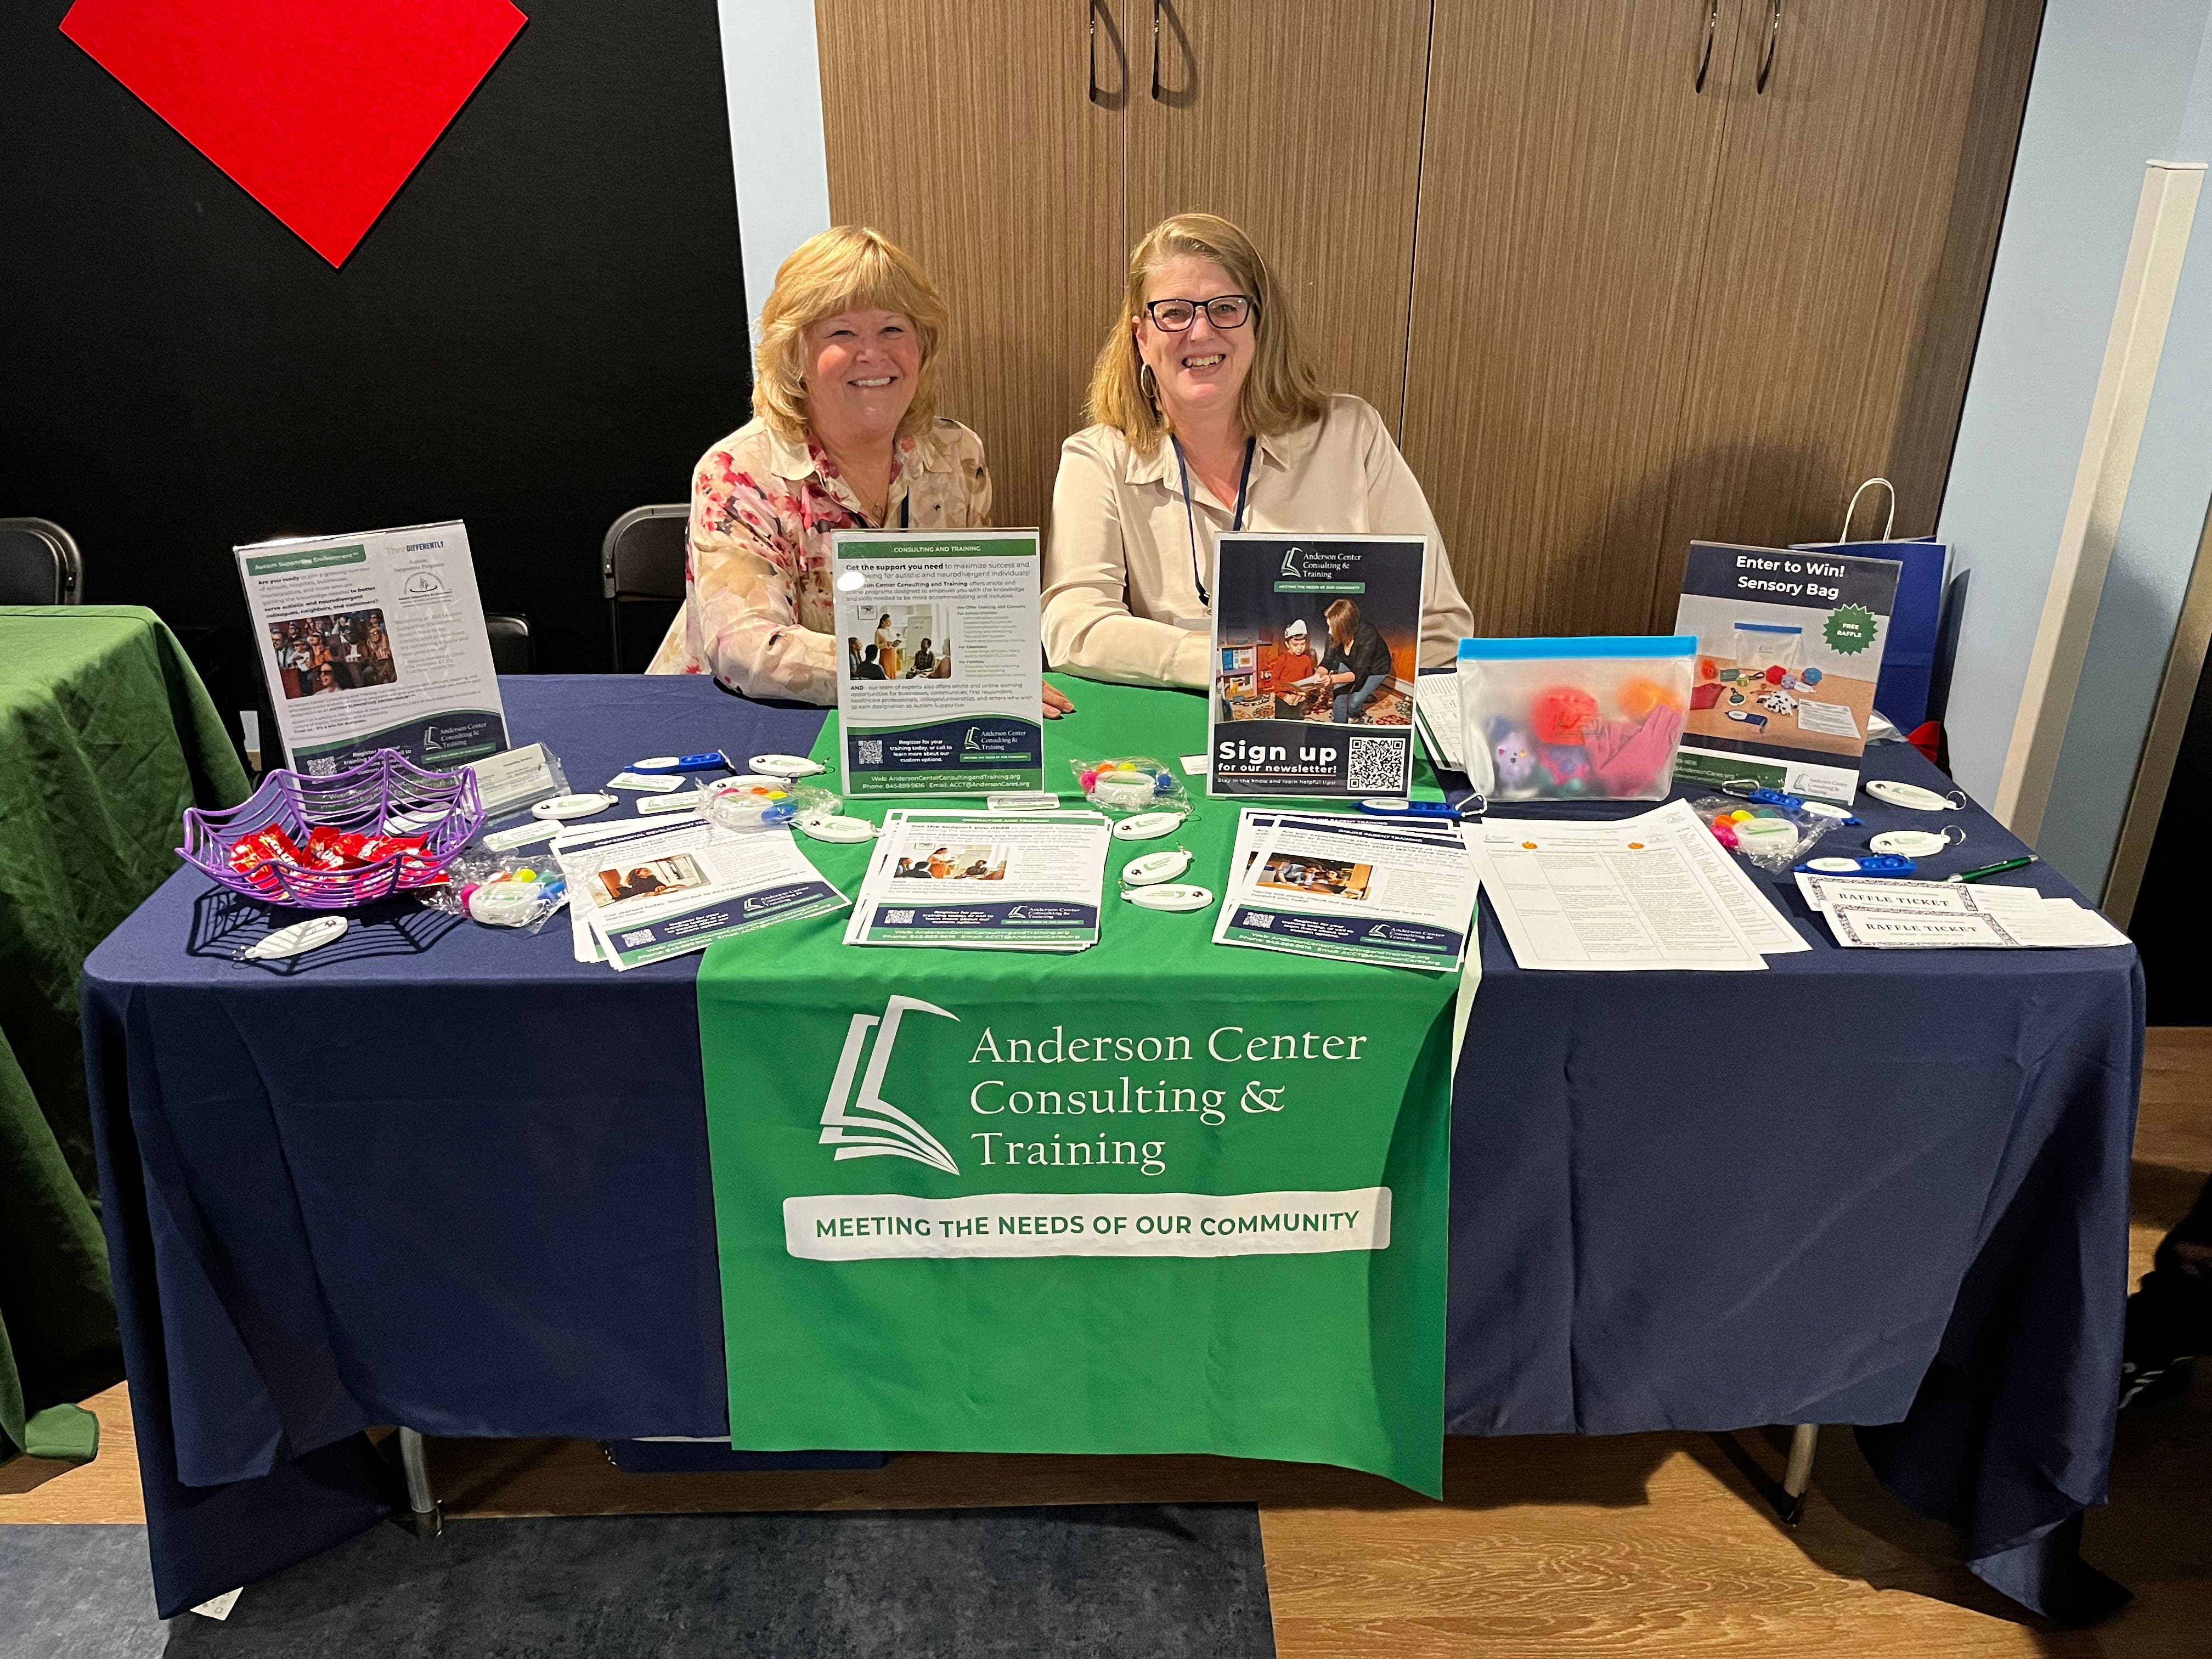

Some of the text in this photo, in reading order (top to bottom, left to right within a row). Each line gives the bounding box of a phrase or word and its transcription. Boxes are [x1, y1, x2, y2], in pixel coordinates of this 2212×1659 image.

[1303, 562, 1341, 571] Consulting
[1303, 571, 1331, 579] Training
[1736, 556, 1845, 577] Enter to Win!
[1737, 577, 1839, 600] Sensory Bag
[1219, 740, 1337, 765] Sign up
[1265, 765, 1336, 773] newsletter!
[1839, 893, 1893, 903] RAFFLE
[1896, 898, 1949, 906] TICKET
[969, 1026, 1366, 1064] Anderson Center
[970, 1077, 1285, 1126] Consulting &
[970, 1132, 1166, 1176] Training
[816, 1211, 1358, 1238] MEETING THE NEEDS OF OUR COMMUNITY
